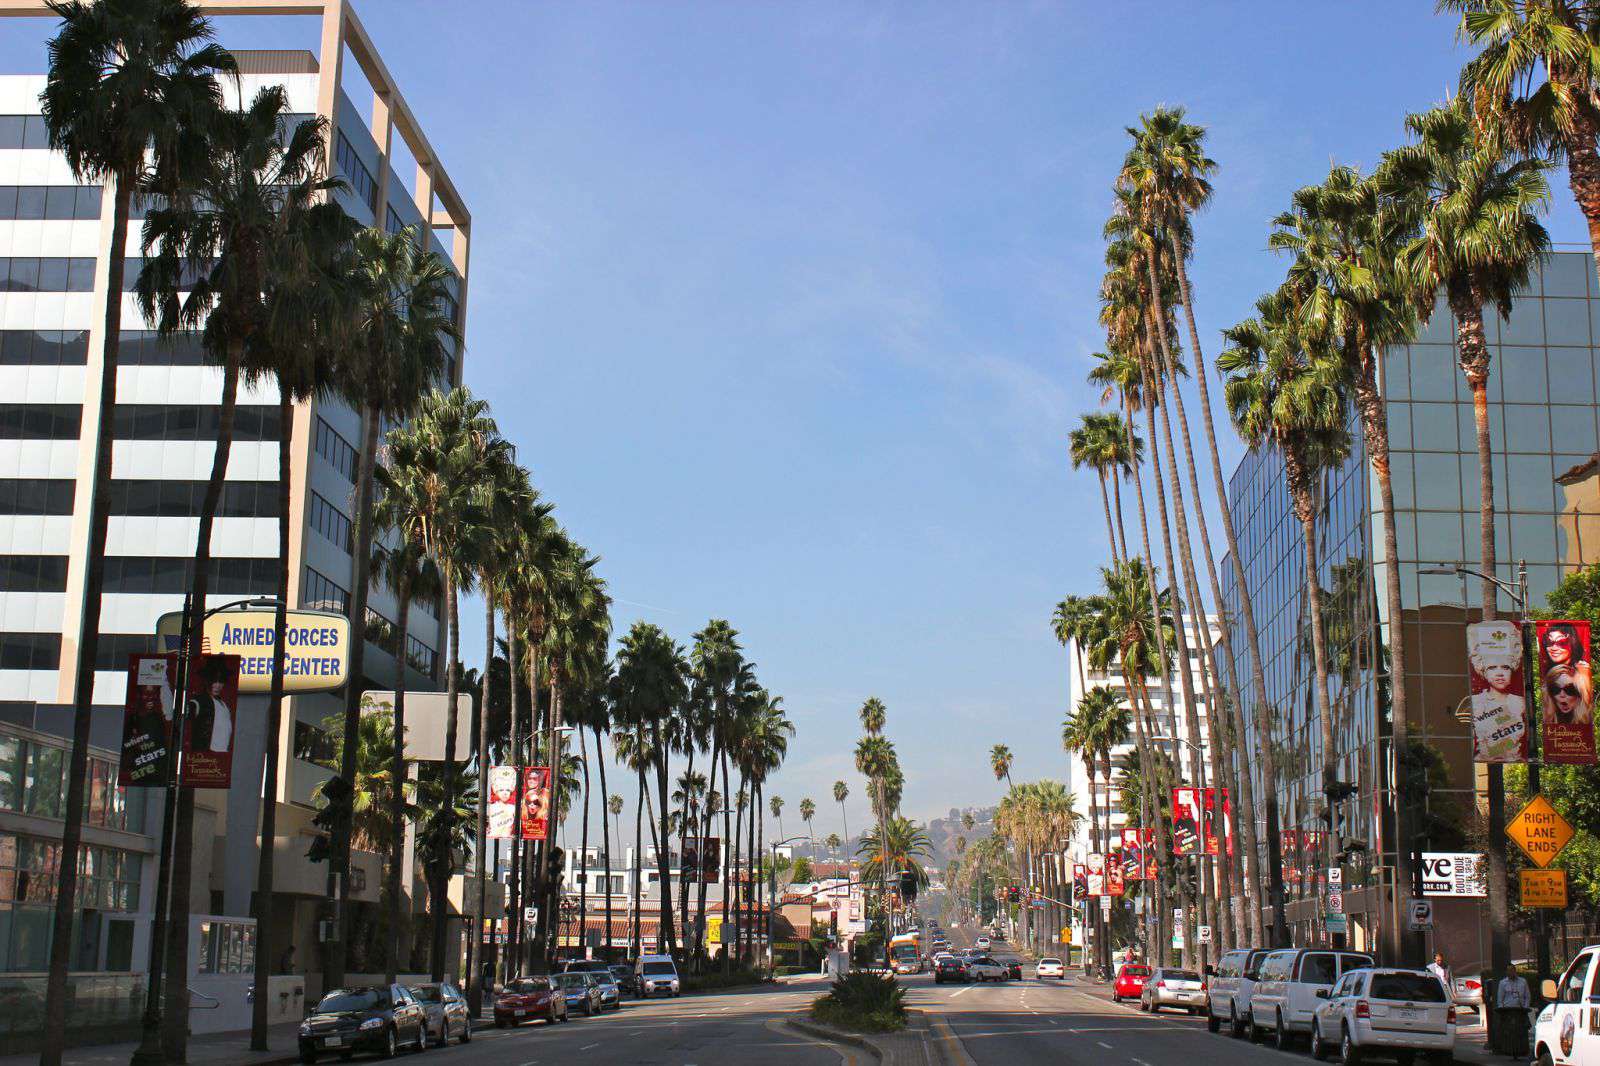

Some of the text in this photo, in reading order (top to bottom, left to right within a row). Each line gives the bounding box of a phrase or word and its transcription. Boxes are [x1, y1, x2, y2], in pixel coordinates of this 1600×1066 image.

[221, 623, 275, 646] ARMED
[1477, 706, 1503, 722] where
[1491, 721, 1524, 741] stars
[124, 733, 150, 748] where
[141, 741, 156, 751] the
[135, 747, 166, 767] stars
[130, 764, 156, 781] are
[1524, 813, 1556, 825] RIGHT
[1526, 827, 1556, 839] LANE
[1527, 841, 1558, 853] ENDS
[1454, 856, 1465, 893] BOUTIQUE
